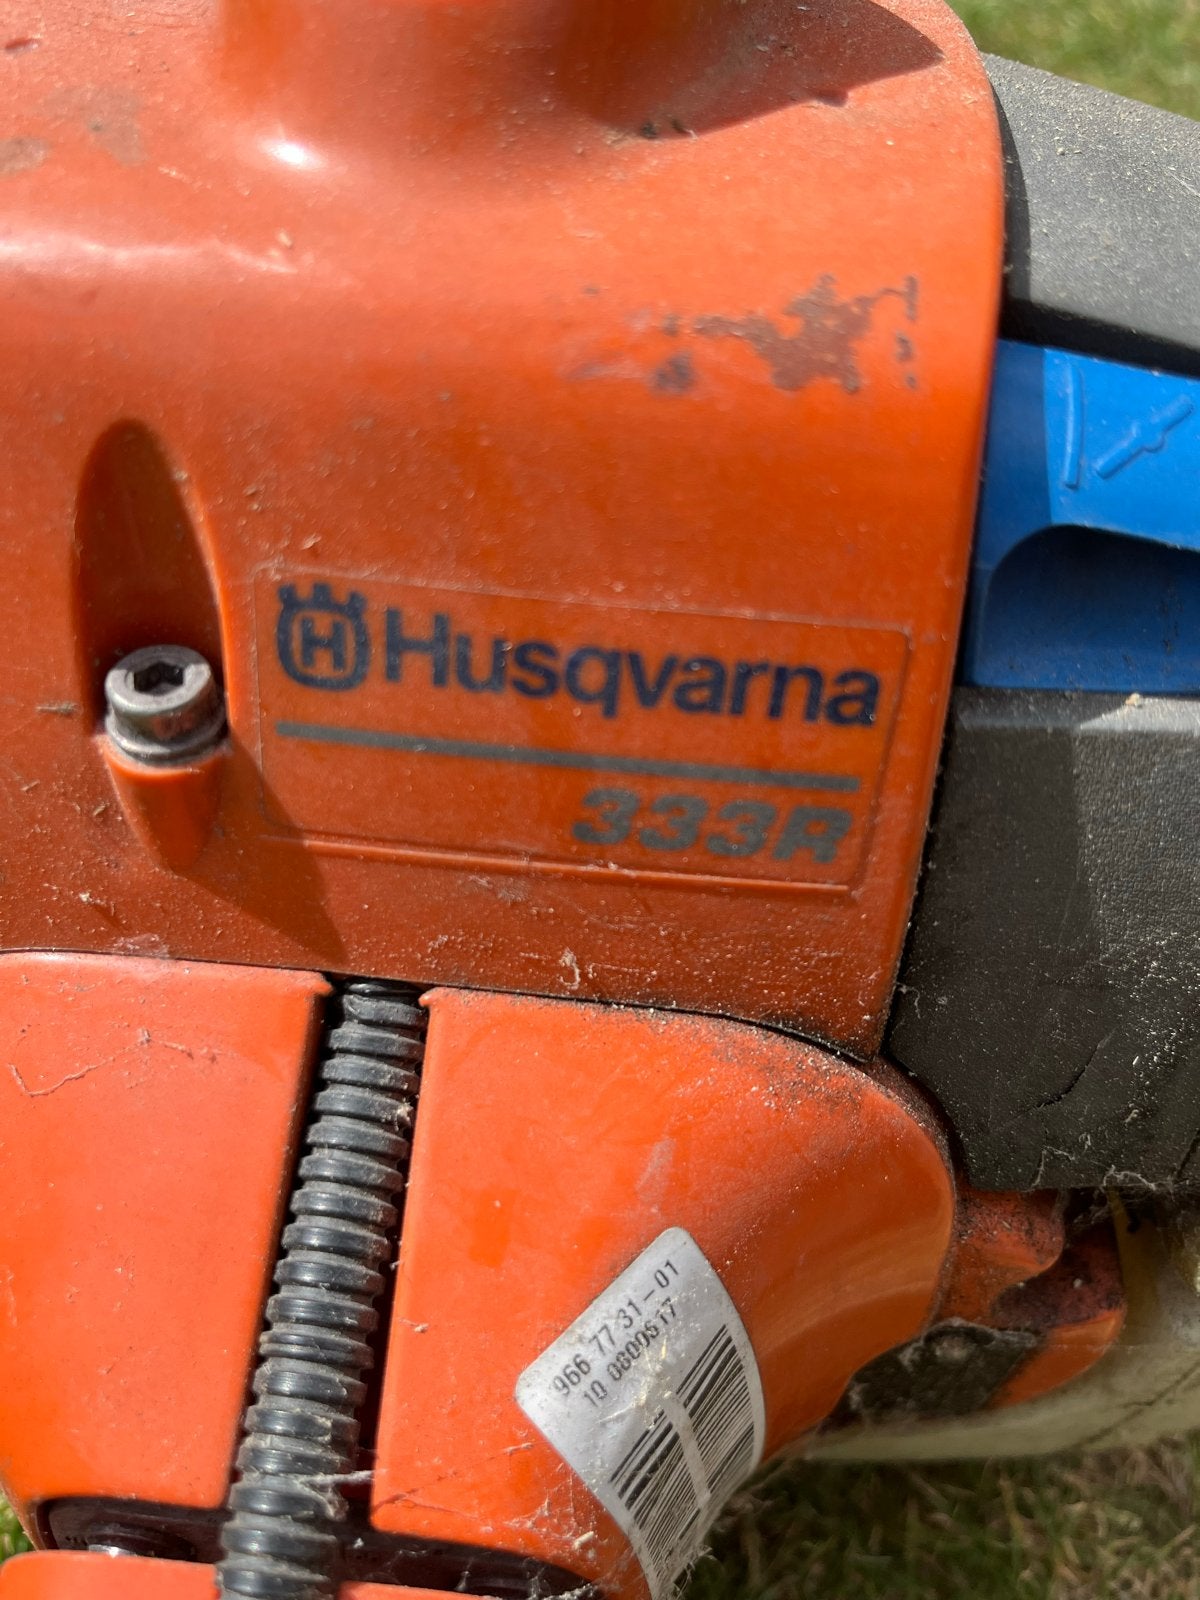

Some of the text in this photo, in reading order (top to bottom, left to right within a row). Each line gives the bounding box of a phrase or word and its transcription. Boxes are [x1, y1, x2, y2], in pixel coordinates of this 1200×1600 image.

[384, 608, 882, 727] Husqvarna
[573, 788, 854, 864] 333R
[553, 1353, 591, 1396] 966
[588, 1323, 615, 1356] 77
[583, 1380, 608, 1408] 10
